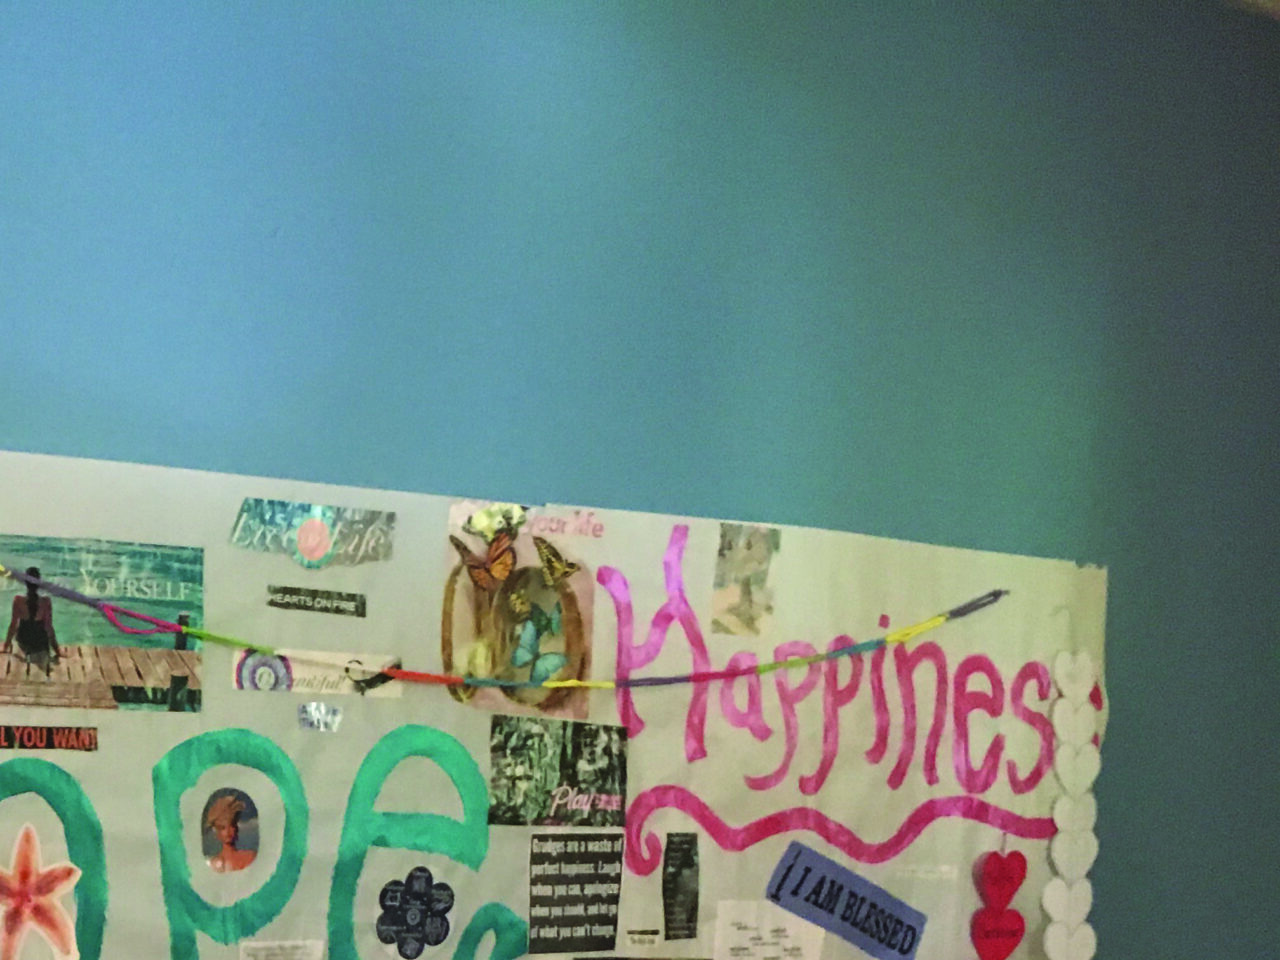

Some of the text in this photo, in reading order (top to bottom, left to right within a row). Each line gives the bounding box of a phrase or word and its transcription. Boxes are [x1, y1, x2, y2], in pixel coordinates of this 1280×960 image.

[314, 598, 331, 608] ON
[13, 726, 47, 747] YOU
[550, 781, 596, 818] Play
[532, 838, 612, 856] Grudges are waste
[531, 861, 560, 878] perfect
[531, 882, 553, 896] when
[554, 884, 567, 899] you
[584, 881, 619, 898] apologize
[531, 904, 550, 917] when
[551, 906, 563, 919] you
[790, 866, 917, 955] I AM BLESSED
[530, 925, 538, 938] of
[539, 925, 558, 938] what
[559, 927, 571, 941] you
[572, 923, 590, 937] can't
